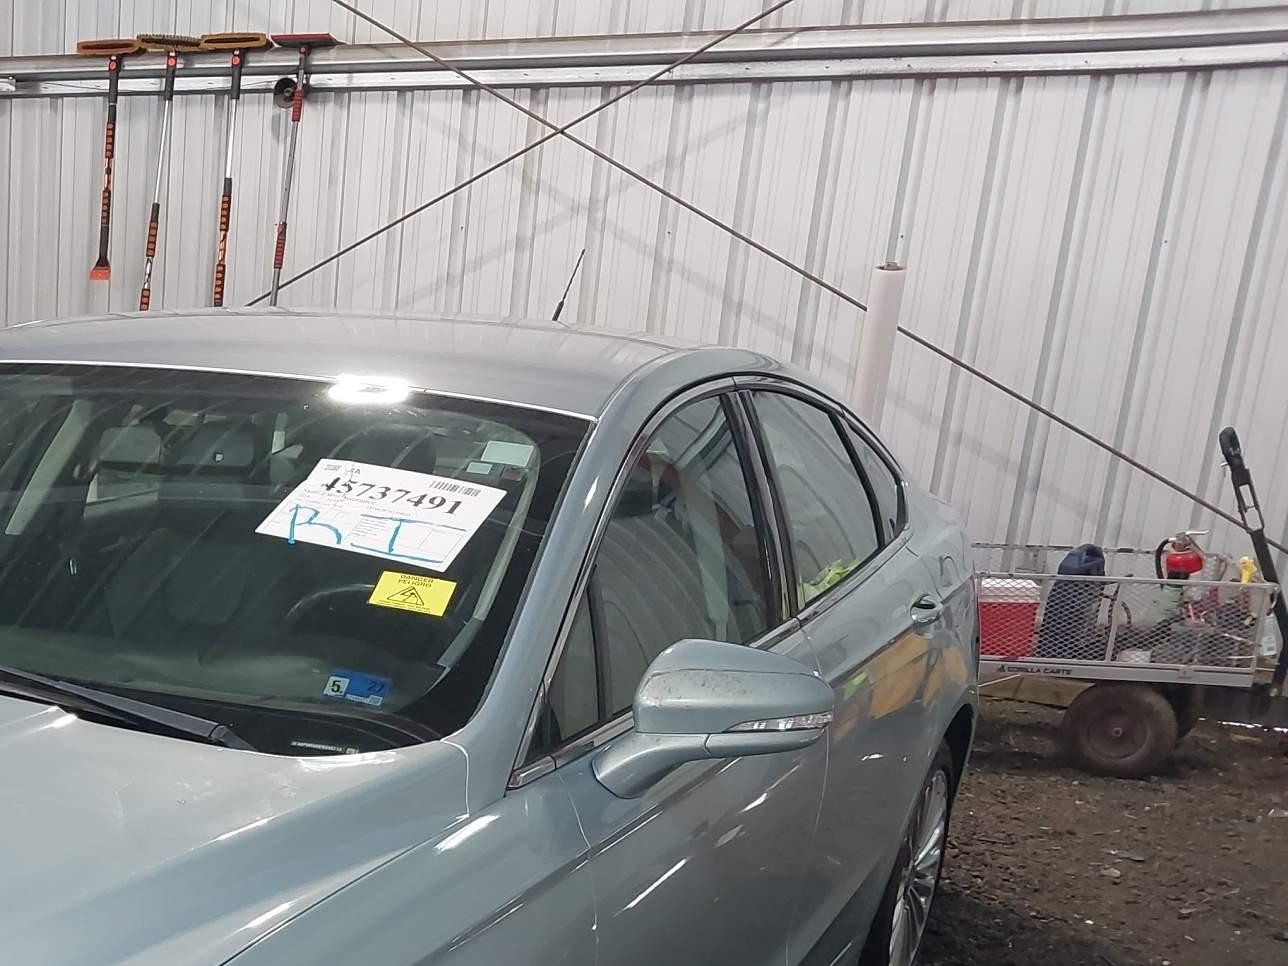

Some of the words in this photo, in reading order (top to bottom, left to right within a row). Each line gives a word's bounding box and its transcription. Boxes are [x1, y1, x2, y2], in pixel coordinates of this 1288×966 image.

[321, 477, 463, 515] 45737491
[397, 579, 433, 588] PELIGRO
[400, 574, 434, 584] DANGER
